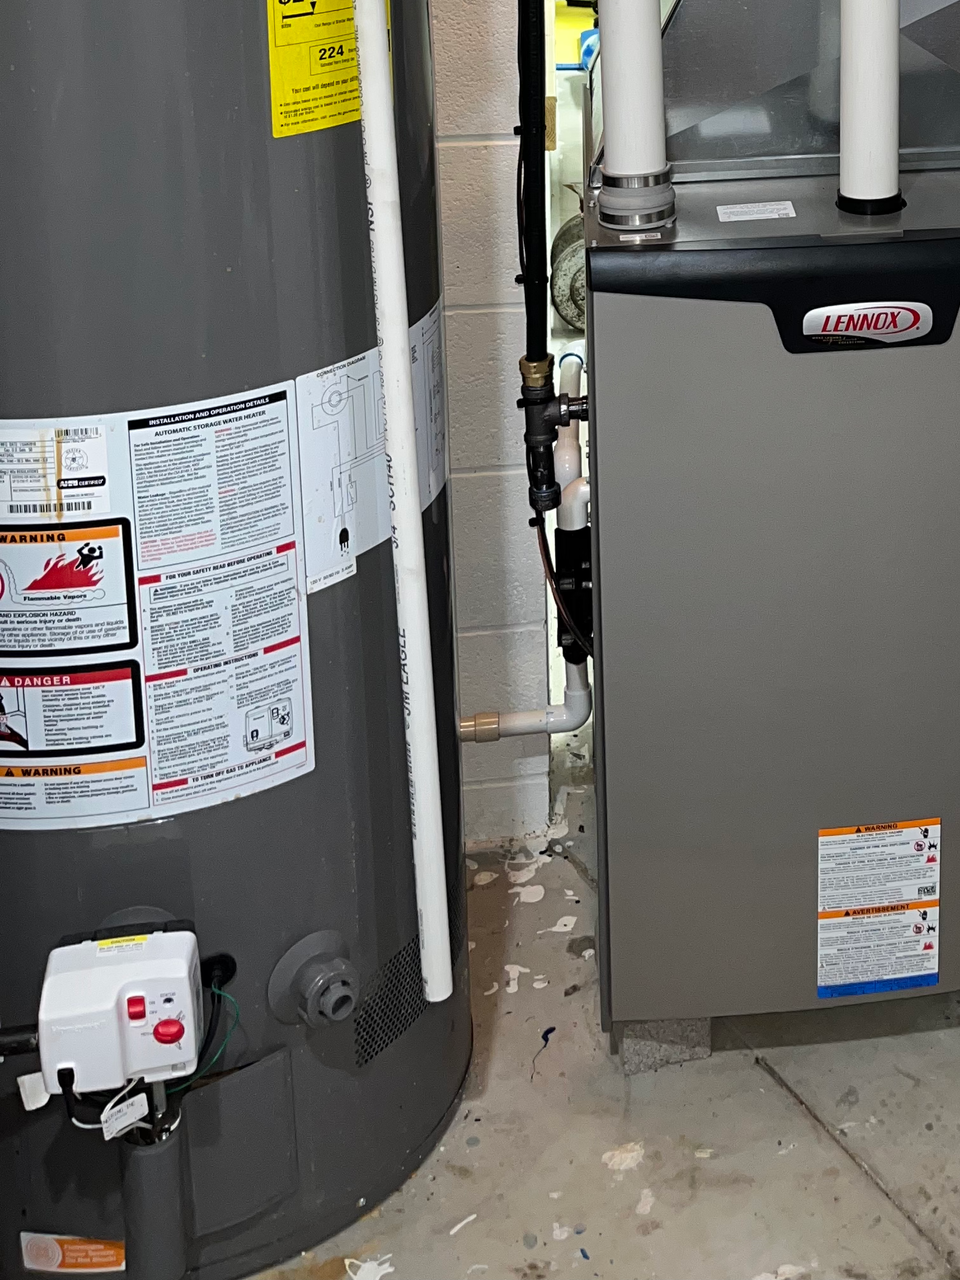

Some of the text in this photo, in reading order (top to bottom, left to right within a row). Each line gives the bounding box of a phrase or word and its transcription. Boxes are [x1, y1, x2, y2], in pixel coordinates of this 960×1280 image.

[318, 44, 344, 61] 224
[821, 310, 902, 333] LENNOX
[149, 414, 194, 426] INSTALLATION
[210, 403, 245, 415] OPERATION
[246, 397, 270, 408] DETAILS
[154, 409, 266, 437] AUTOMATIC STORAGE WATER HEATER
[0, 533, 66, 544] WARNING
[177, 570, 192, 579] YOUR
[192, 567, 212, 576] SAFETY
[212, 563, 226, 571] READ
[227, 558, 246, 568] BEFORE
[246, 550, 273, 563] OPERATING
[63, 593, 87, 601] Vapors
[193, 661, 222, 673] OPERATING
[223, 651, 259, 666] INSTRUCTIONS
[14, 675, 71, 686] DANGER
[21, 766, 82, 777] WARNING
[199, 773, 214, 781] TURN
[225, 767, 237, 775] GAS
[244, 755, 272, 769] APPLIANCE
[864, 823, 898, 832] WARNING
[851, 904, 910, 916] AVERTISSEMENT
